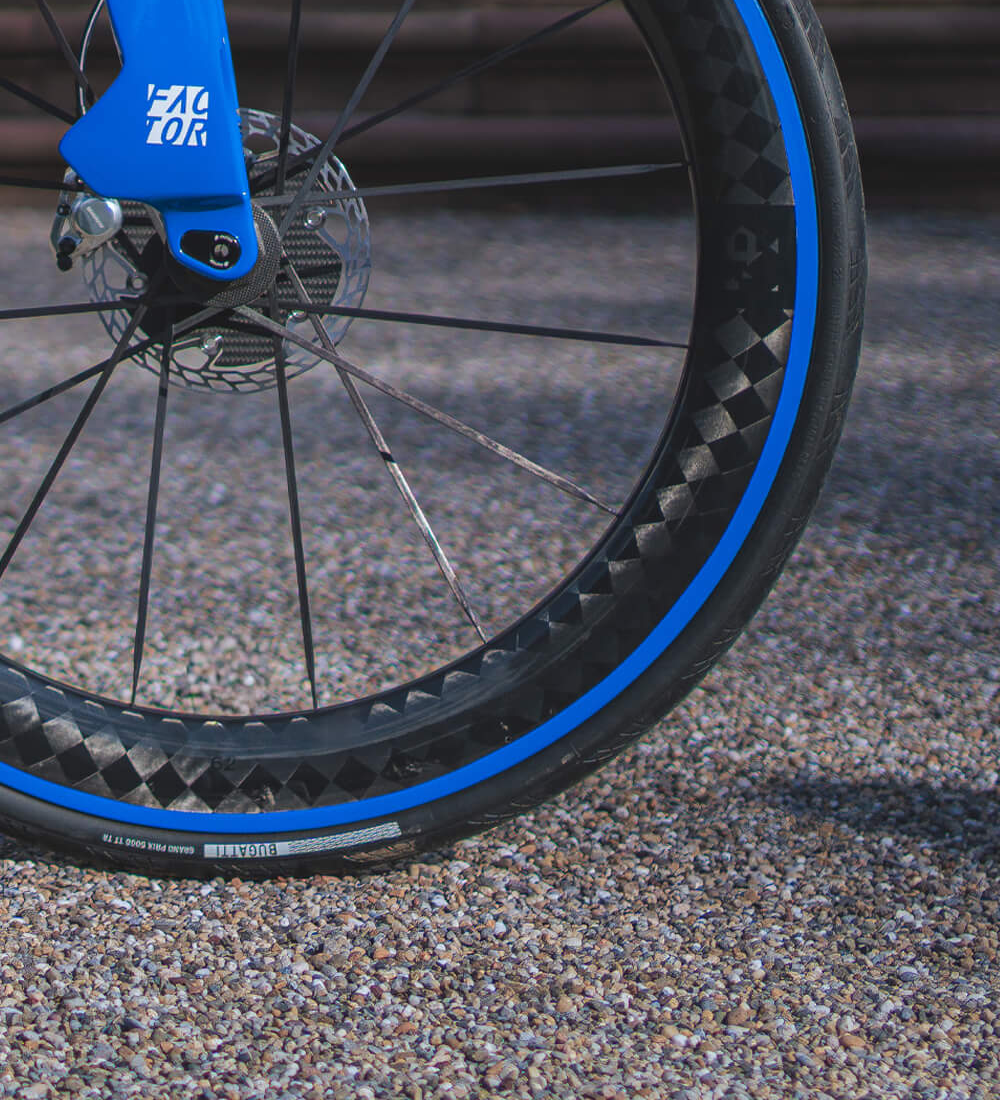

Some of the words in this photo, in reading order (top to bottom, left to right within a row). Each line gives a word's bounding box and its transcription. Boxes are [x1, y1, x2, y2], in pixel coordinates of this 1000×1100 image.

[147, 842, 167, 852] PRIX
[167, 844, 195, 855] GRAND
[216, 844, 277, 857] BUGATTI
